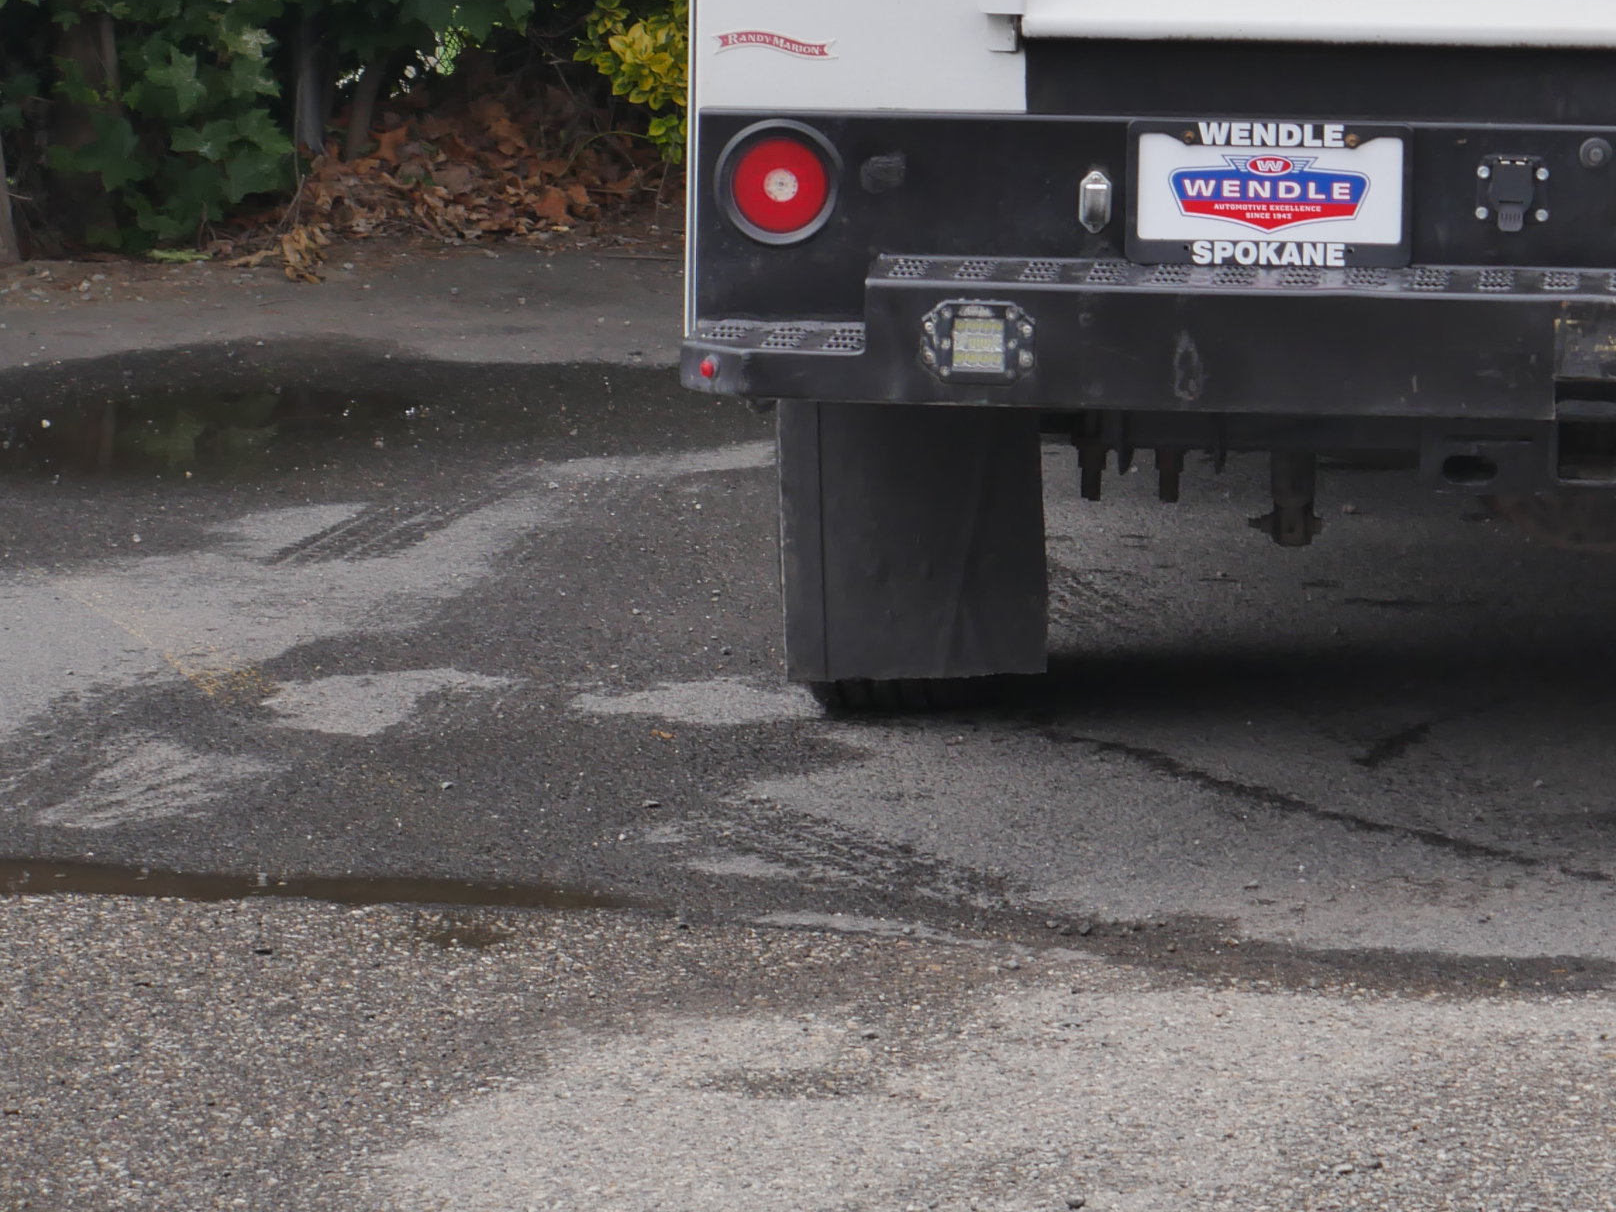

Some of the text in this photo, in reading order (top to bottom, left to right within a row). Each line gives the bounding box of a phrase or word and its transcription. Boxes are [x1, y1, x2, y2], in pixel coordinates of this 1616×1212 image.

[772, 36, 820, 55] MARION
[1198, 121, 1345, 148] WENDLE
[1183, 178, 1352, 200] WENDLE
[1213, 203, 1322, 212] AUTOMOTIVE EXCELLENCE
[1245, 212, 1271, 220] SINCE
[1192, 240, 1346, 267] SPOKANE
